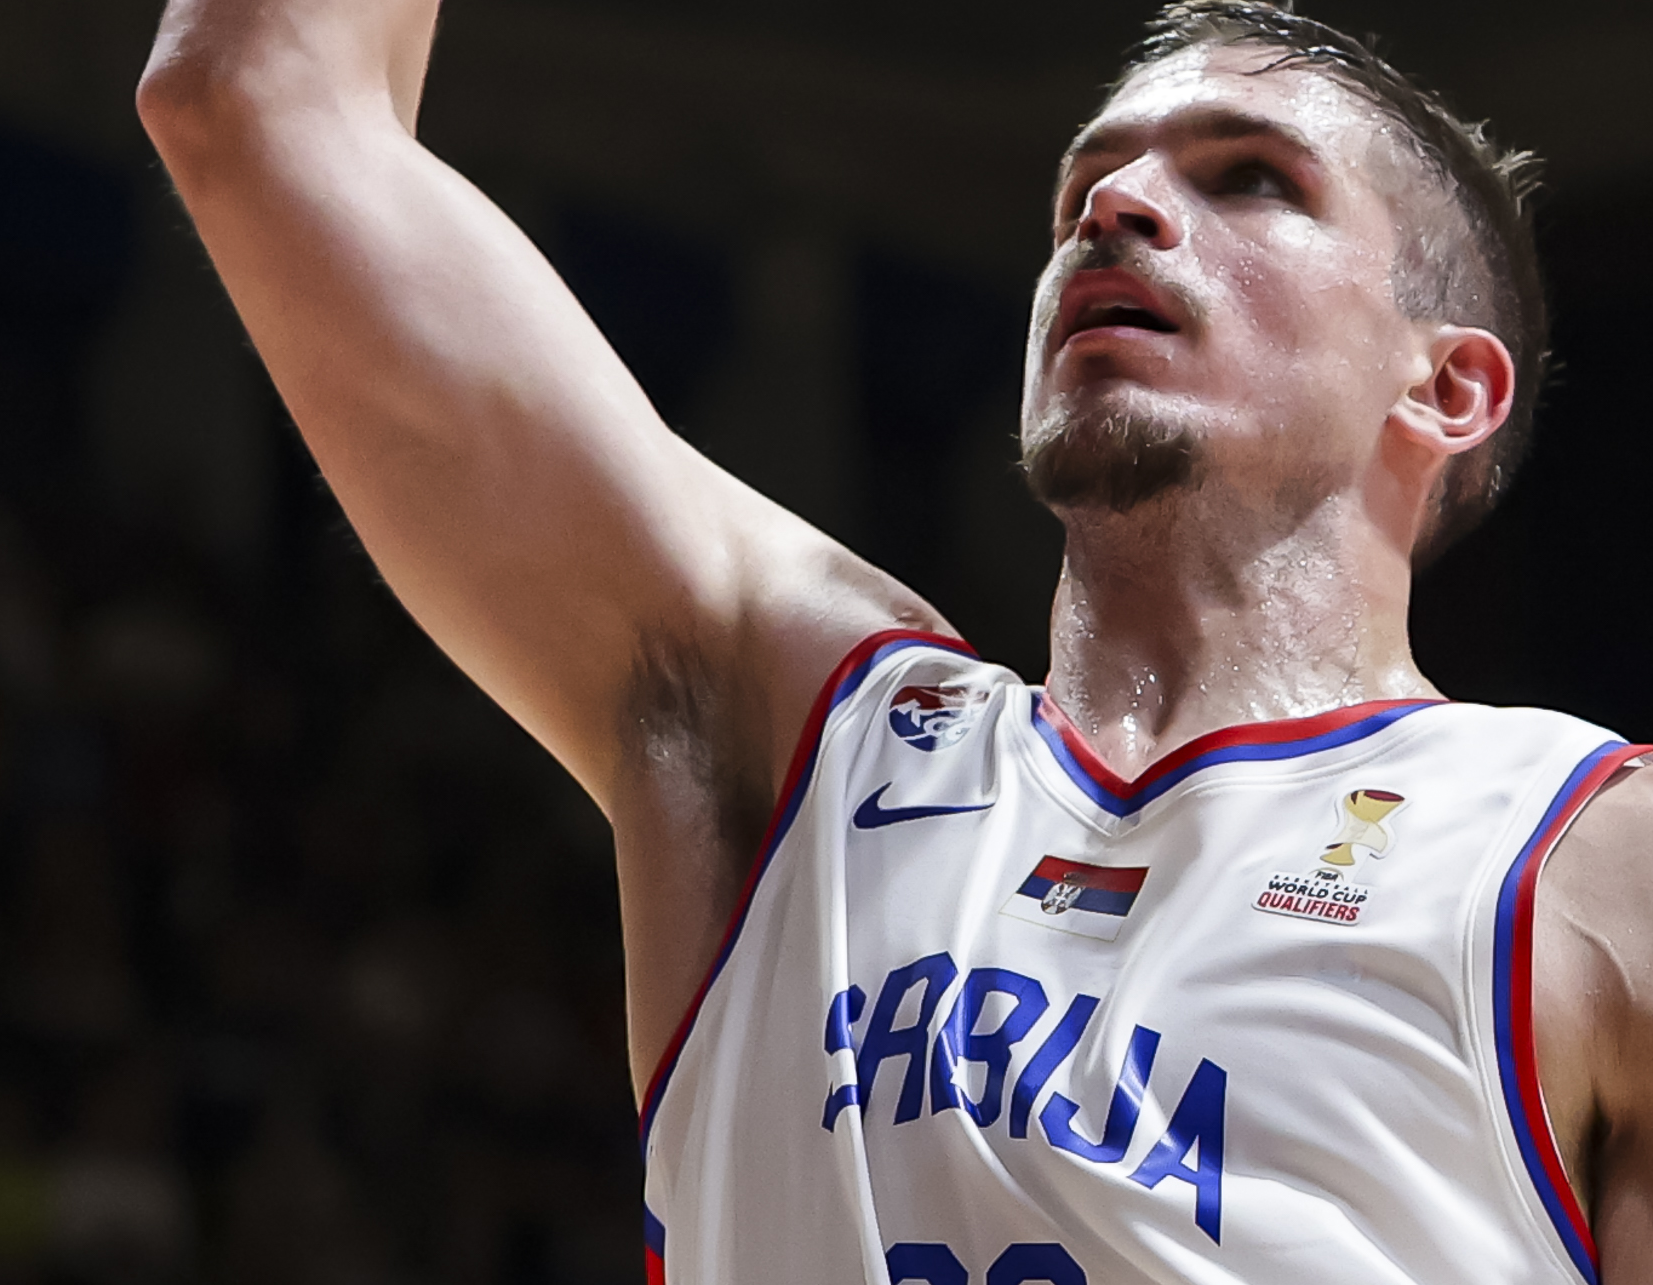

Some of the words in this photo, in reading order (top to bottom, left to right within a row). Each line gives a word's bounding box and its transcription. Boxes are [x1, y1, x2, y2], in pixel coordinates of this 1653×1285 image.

[1256, 891, 1361, 922] QUALIFIERS
[1268, 880, 1329, 899] WORLD
[1332, 891, 1368, 905] CUP
